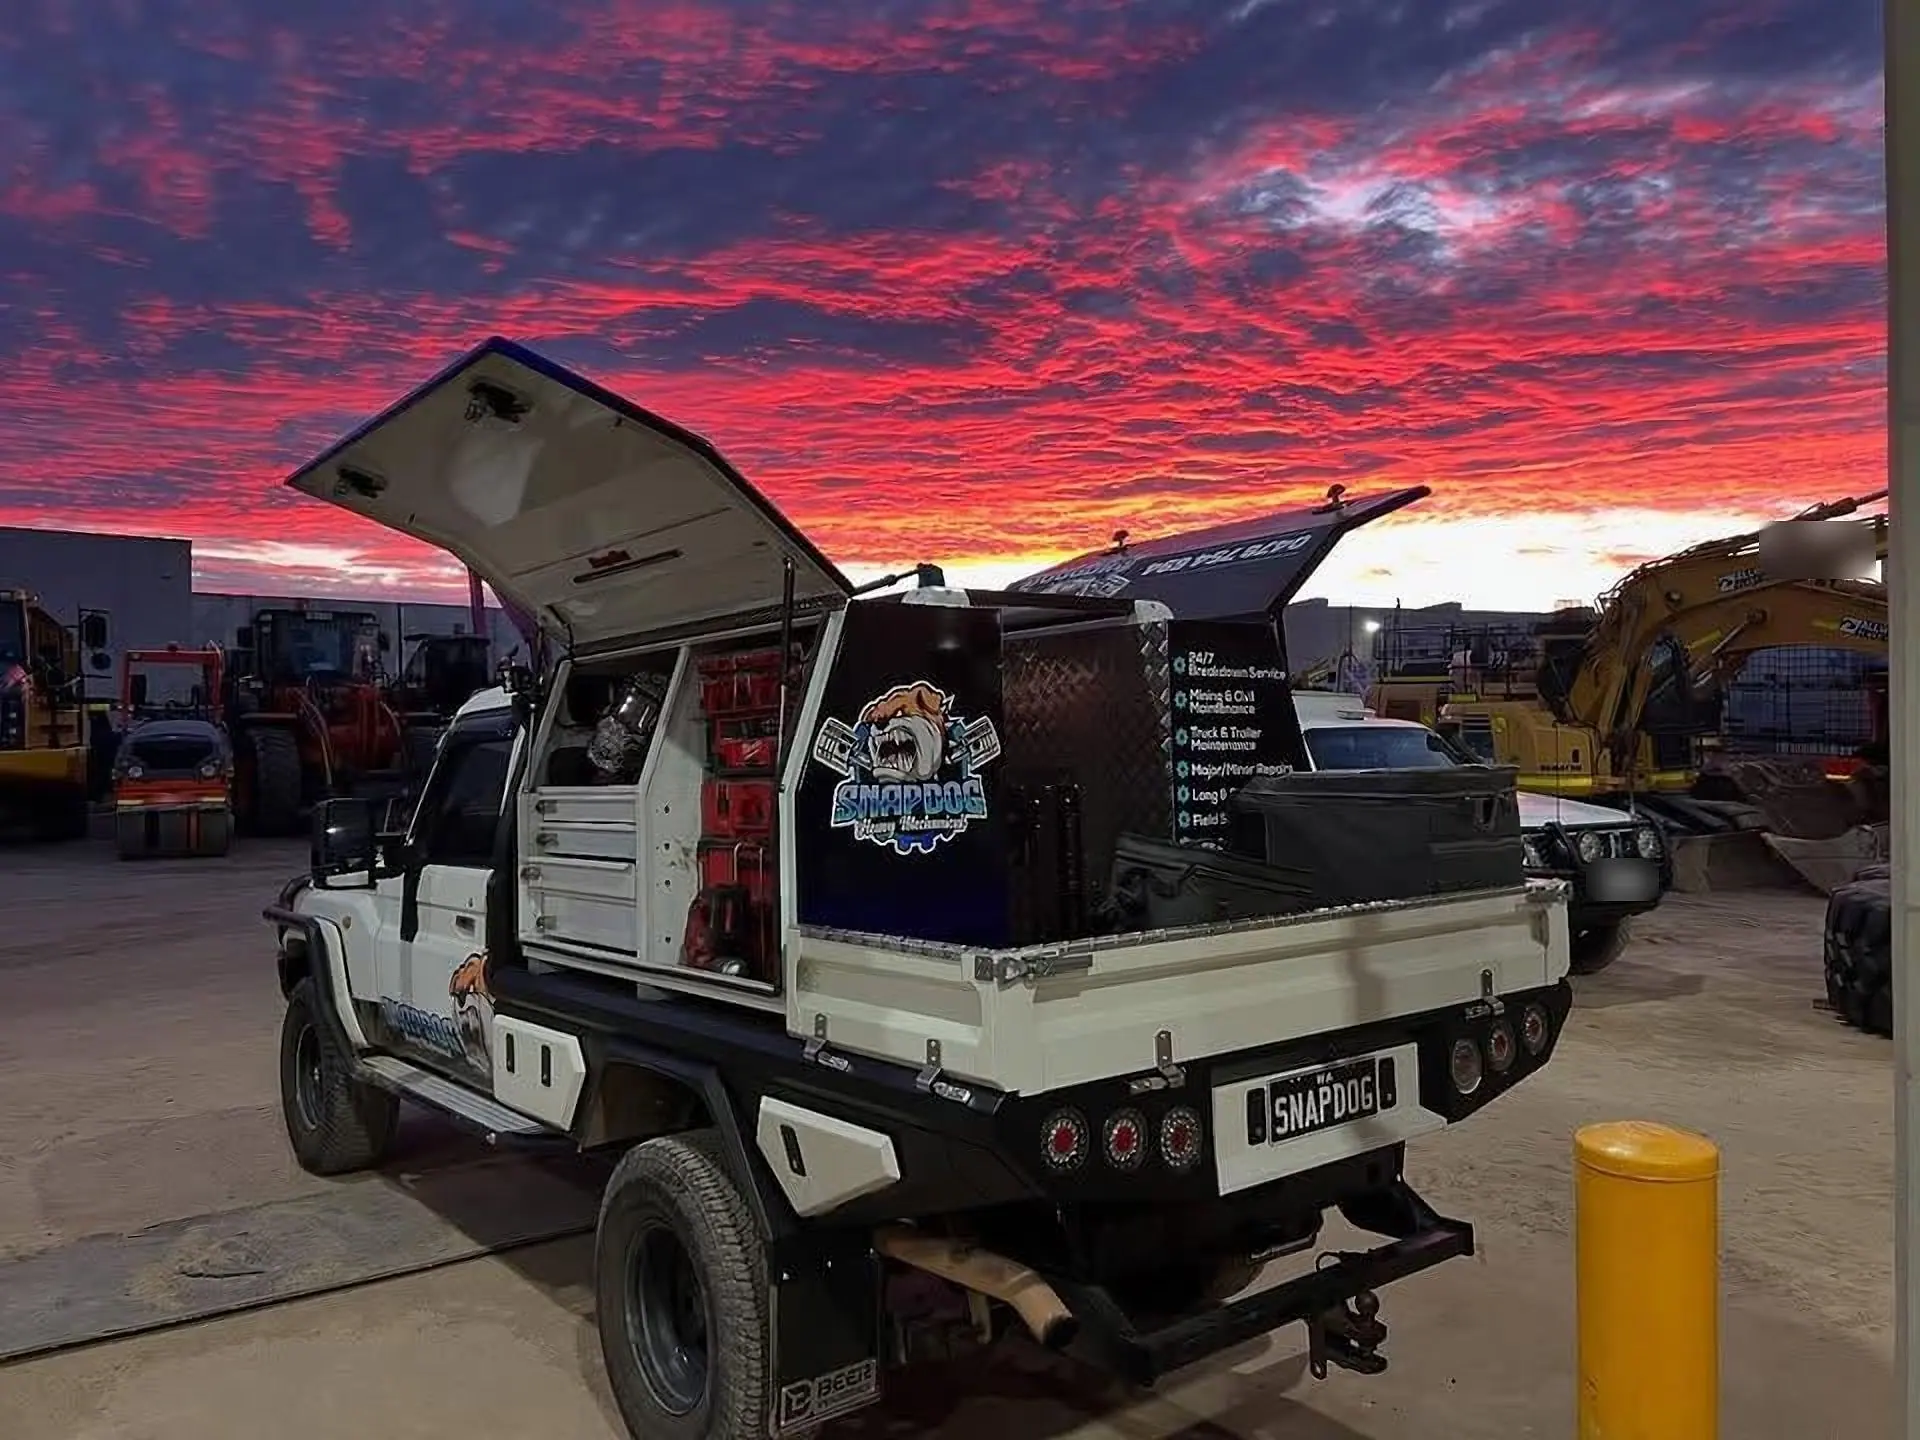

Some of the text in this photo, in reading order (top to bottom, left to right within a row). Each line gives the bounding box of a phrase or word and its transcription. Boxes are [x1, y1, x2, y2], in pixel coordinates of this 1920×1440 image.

[1188, 651, 1214, 664] 24/7
[1188, 663, 1286, 680] Breakdown Service
[1189, 688, 1222, 703] Mining
[1190, 701, 1256, 714] Maintenance
[1190, 725, 1218, 738] Truck
[1230, 725, 1262, 738] Trailer
[835, 779, 984, 822] SNAPDOG
[1192, 788, 1218, 805] Long
[1274, 1075, 1372, 1135] SNAPDOG
